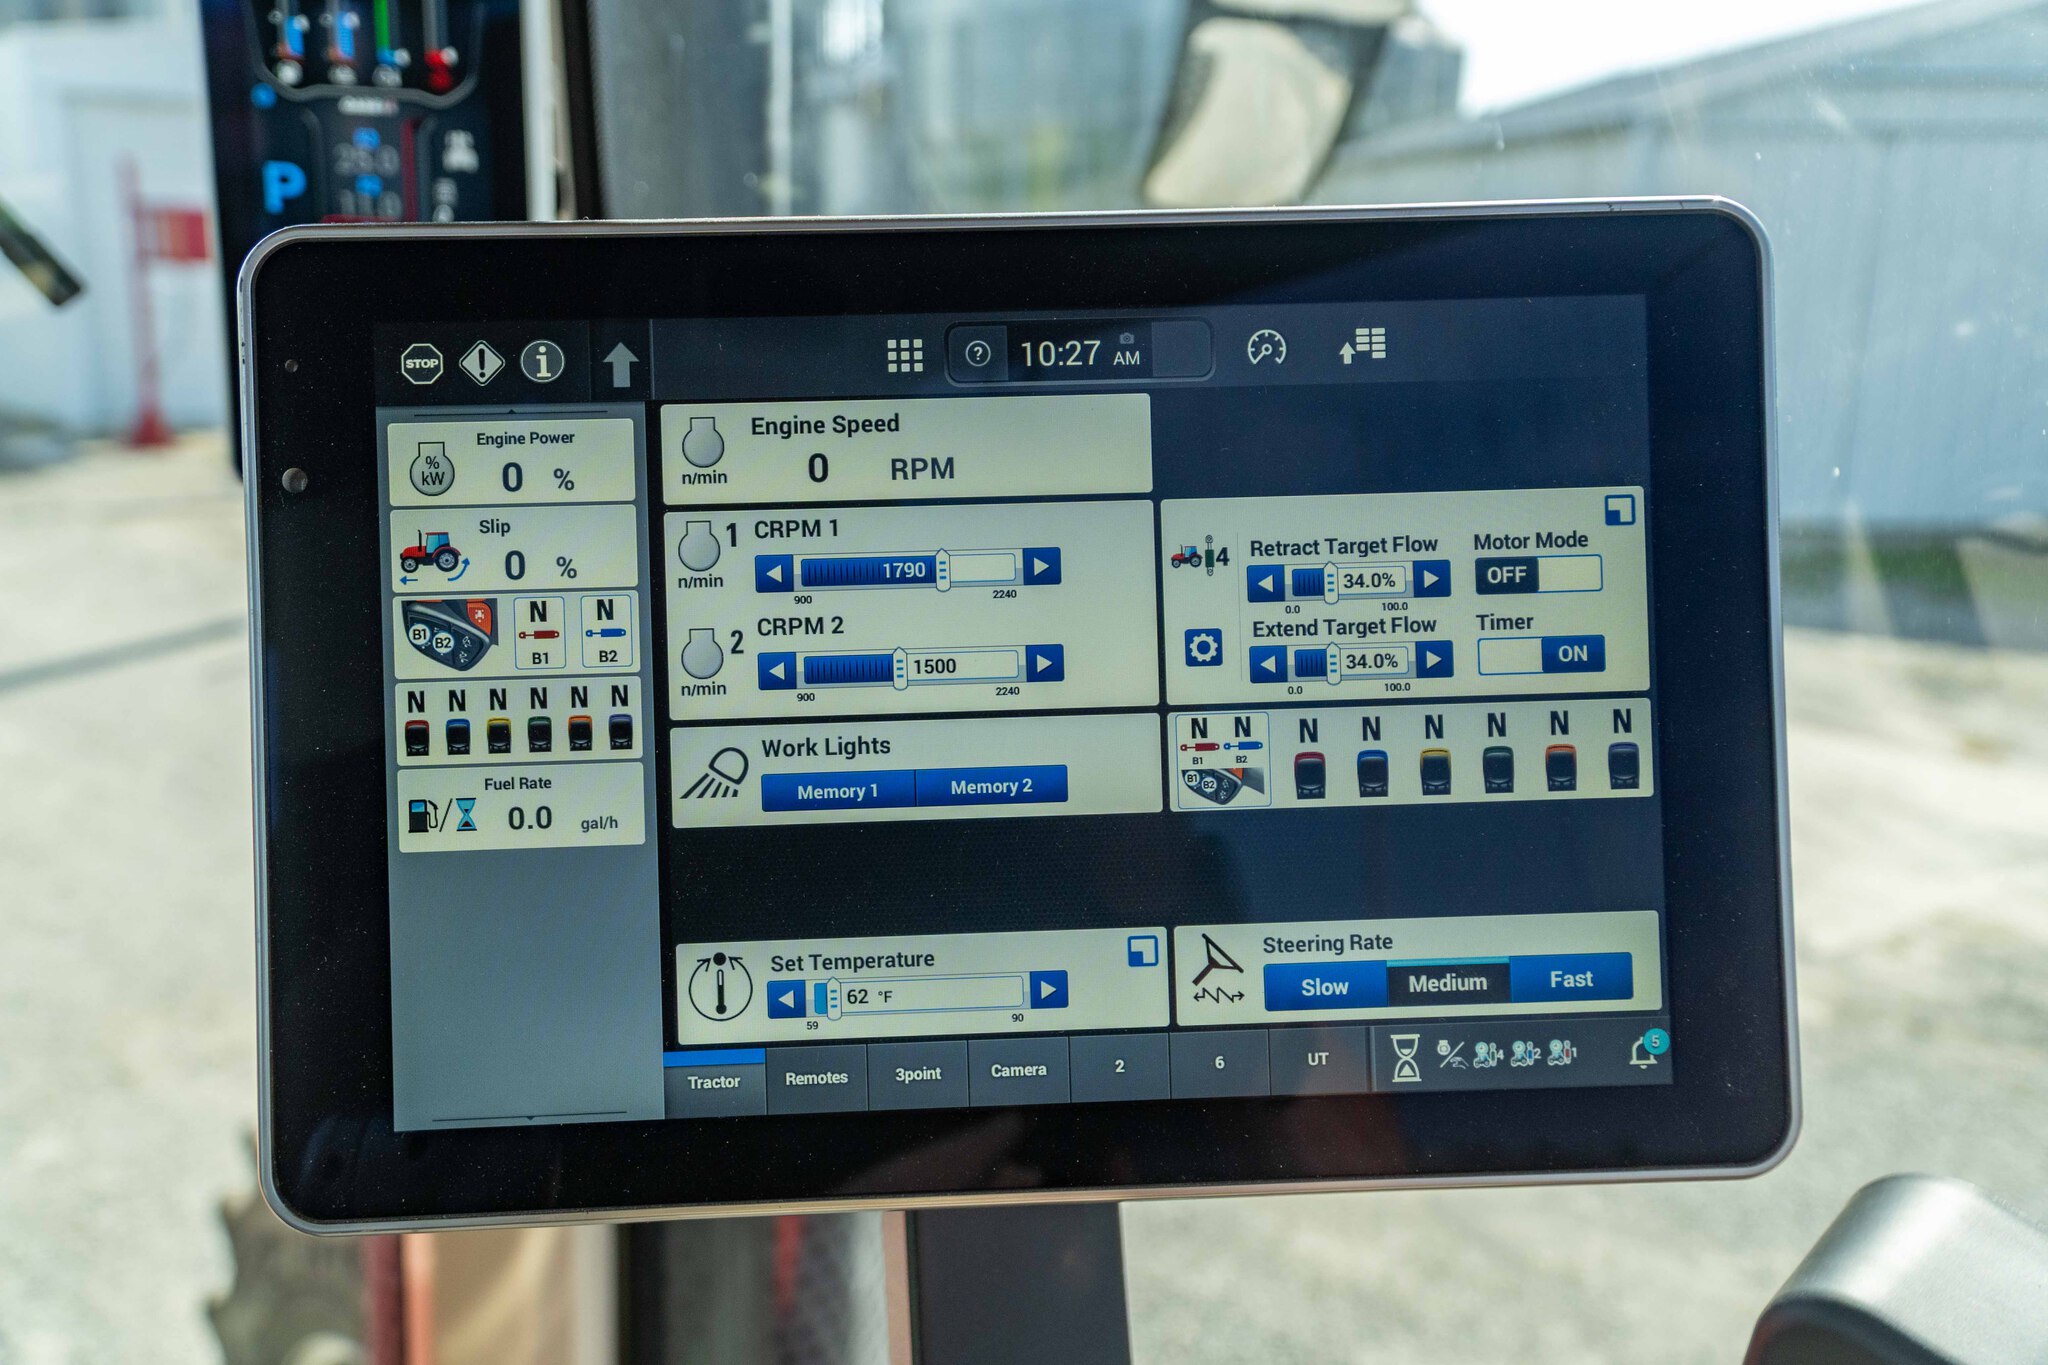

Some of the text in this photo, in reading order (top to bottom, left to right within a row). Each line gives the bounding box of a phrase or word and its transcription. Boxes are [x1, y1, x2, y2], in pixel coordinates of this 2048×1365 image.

[262, 160, 307, 214] P
[1021, 339, 1140, 368] 10:27 AM
[406, 359, 438, 369] STOP
[751, 413, 900, 439] Engine Speed
[476, 432, 575, 448] Engine Power
[425, 456, 440, 469] %
[808, 453, 955, 483] 0 RPM
[421, 472, 445, 486] kW
[502, 462, 575, 492] 0 %
[682, 470, 728, 485] n/min
[479, 519, 511, 536] Slip
[725, 523, 738, 547] 1
[754, 519, 839, 539] CRPM 1
[1250, 536, 1438, 558] Retract Target Flow
[1473, 531, 1589, 550] Motor Mode
[505, 550, 577, 580] 0 %
[1215, 548, 1230, 566] 4
[883, 562, 926, 579] 1790
[1487, 566, 1527, 584] OFF
[678, 574, 724, 589] n/min
[1343, 572, 1396, 589] 34.0%
[794, 595, 812, 605] 900
[992, 590, 1017, 599] 2240
[529, 600, 547, 623] N
[596, 599, 614, 621] N
[1285, 605, 1300, 614] 0.0
[1382, 602, 1408, 611] 100.0
[757, 616, 844, 637] CRPM 2
[1252, 616, 1437, 638] Extend Target Flow
[1477, 614, 1533, 631] Timer
[413, 628, 427, 640] B1
[435, 637, 452, 648] B2
[730, 630, 744, 654] 2
[532, 652, 549, 664] B1
[599, 651, 618, 662] B2
[1346, 653, 1399, 670] 34.0%
[1558, 645, 1588, 662] ON
[913, 658, 957, 676] 1500
[611, 685, 629, 707] N
[681, 681, 727, 697] n/min
[995, 687, 1020, 696] 2240
[1288, 686, 1303, 695] 0.0
[1384, 682, 1411, 692] 100.0
[407, 690, 425, 713] N
[448, 689, 466, 712] N
[489, 688, 507, 710] N
[530, 687, 548, 709] N
[571, 686, 588, 708] N
[796, 692, 815, 702] 900
[1191, 718, 1208, 739] N
[1234, 716, 1251, 737] N
[1362, 716, 1381, 741] N
[1425, 714, 1444, 739] N
[1488, 712, 1506, 738] N
[1550, 710, 1569, 736] N
[1613, 708, 1632, 734] N
[1299, 718, 1318, 743] N
[761, 736, 891, 759] Work Lights
[484, 777, 552, 790] Fuel Rate
[797, 783, 878, 802] Memory 1
[951, 778, 1033, 798] Memory 2
[508, 805, 618, 833] 0.0 gal/h
[1263, 933, 1394, 958] Steering Rate
[771, 951, 935, 973] Set Temperature
[1301, 978, 1349, 996] Slow
[1408, 974, 1488, 993] Medium
[1550, 971, 1594, 988] Fast
[847, 988, 892, 1005] 62 °F
[806, 1021, 819, 1030] 59
[1011, 1014, 1024, 1023] 90
[1652, 1036, 1659, 1047] 5
[1308, 1052, 1329, 1066] UT
[1497, 1050, 1504, 1060] 4
[1534, 1048, 1541, 1059] 2
[1572, 1048, 1576, 1057] 1
[990, 1062, 1047, 1079] Camera
[1115, 1060, 1125, 1073] 2
[1215, 1055, 1225, 1069] 6
[687, 1074, 741, 1090] Tractor
[785, 1070, 848, 1086] Remotes
[895, 1066, 942, 1084] 3point
